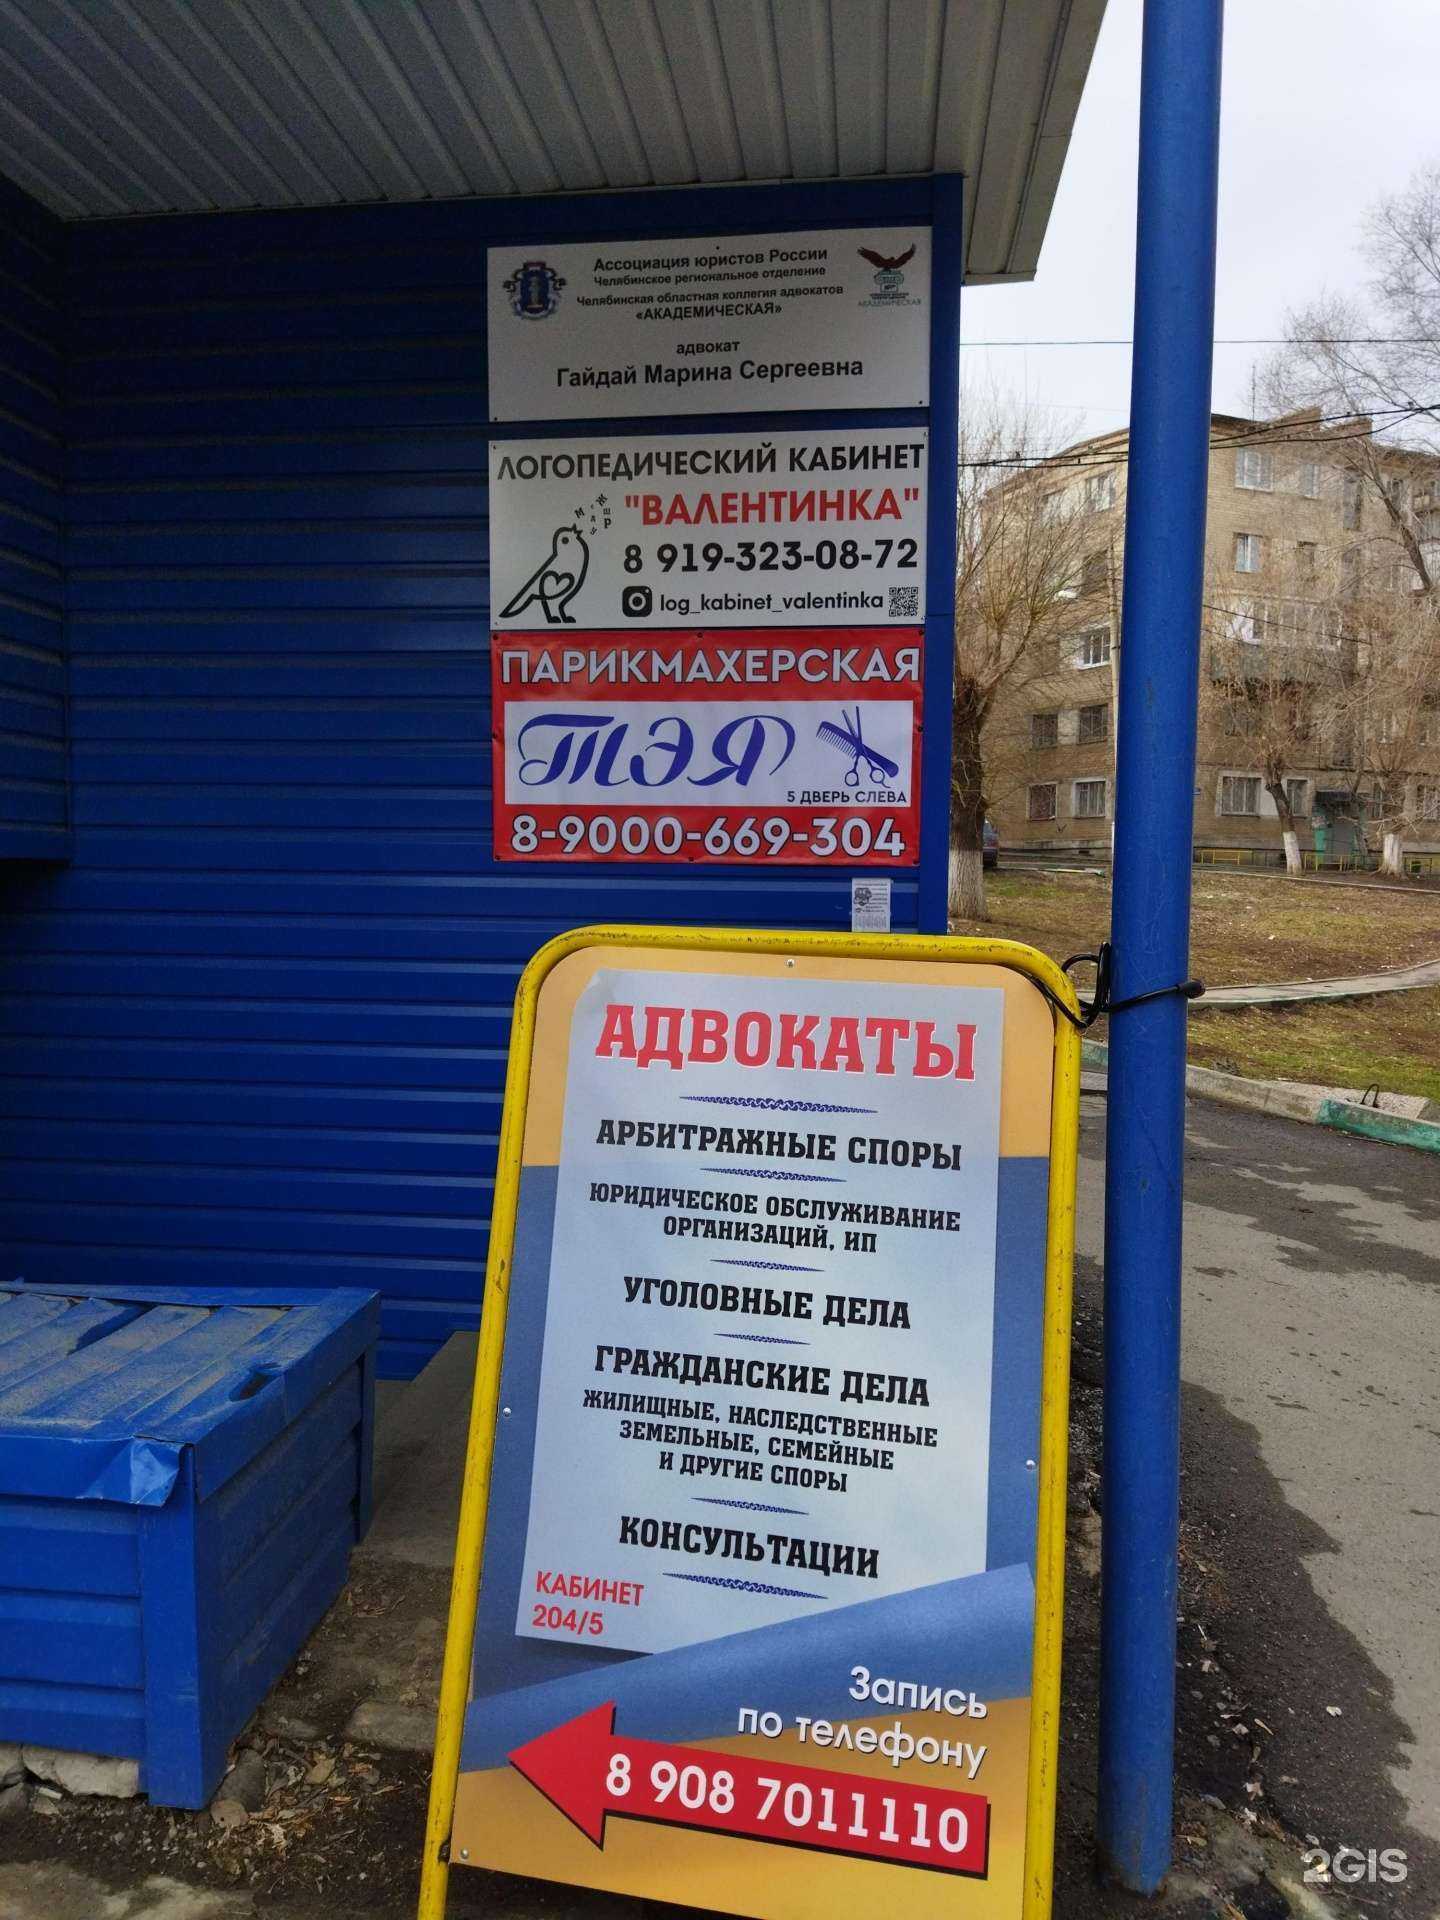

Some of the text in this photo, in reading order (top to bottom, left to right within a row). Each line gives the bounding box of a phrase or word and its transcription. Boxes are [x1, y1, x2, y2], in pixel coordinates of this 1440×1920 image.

[594, 248, 828, 271] Ассоциация юристов России
[594, 266, 826, 287] Челябинское региональное отделение
[577, 285, 844, 306] Челябинская областная коллегия адвокатов
[635, 301, 783, 320] «АКАДЕМИЧЕСКАЯ»
[676, 340, 741, 355] адвокат
[557, 360, 864, 389] Гайдай Марина Сергеевна
[497, 442, 925, 481] ЛОГОПЕДИЧЕСКИЙ КАБИНЕТ
[624, 487, 919, 526] "ВАЛЕНТИНКА"
[624, 538, 919, 573] 8 919-323-08-72
[660, 591, 884, 616] log_kabinet_valentinka
[502, 648, 920, 684] ПАРИКМАХЕРСКАЯ
[787, 791, 907, 804] 5 ДВЕРЬ СЛЕВА
[511, 815, 905, 856] 8-9000-669-304
[595, 1003, 977, 1081] АДВОКАТЫ
[596, 1119, 962, 1171] АРБИТРАЖНЫЕ СПОРЫ
[589, 1183, 961, 1232] ЮРИДИЧЕСКОЕ ОБСЛУЖИВАНИЕ
[663, 1218, 877, 1252] ОРГАНИЗАЦИЙ, ИП
[623, 1276, 911, 1329] УГОЛОВНЫЕ ДЕЛА
[594, 1344, 929, 1406] ГРАЖДАНСКИЕ ДЕЛА
[582, 1388, 938, 1447] ЖИЛИЩНЫЕ, НАСЛЕДСТВЕННЫЕ
[619, 1420, 894, 1470] ЗЕМЕЛЬНЫЕ, СЕМЕЙНЫЕ
[658, 1452, 848, 1492] И ДРУГИЕ СПОРЫ
[619, 1516, 880, 1579] КОНСУЛЬТАЦИИ
[536, 1571, 644, 1606] КАБИНЕТ
[532, 1604, 604, 1635] 204/5
[848, 1666, 988, 1719] Запись
[738, 1707, 988, 1780] по телефону
[605, 1753, 969, 1855] 8 908 7011110
